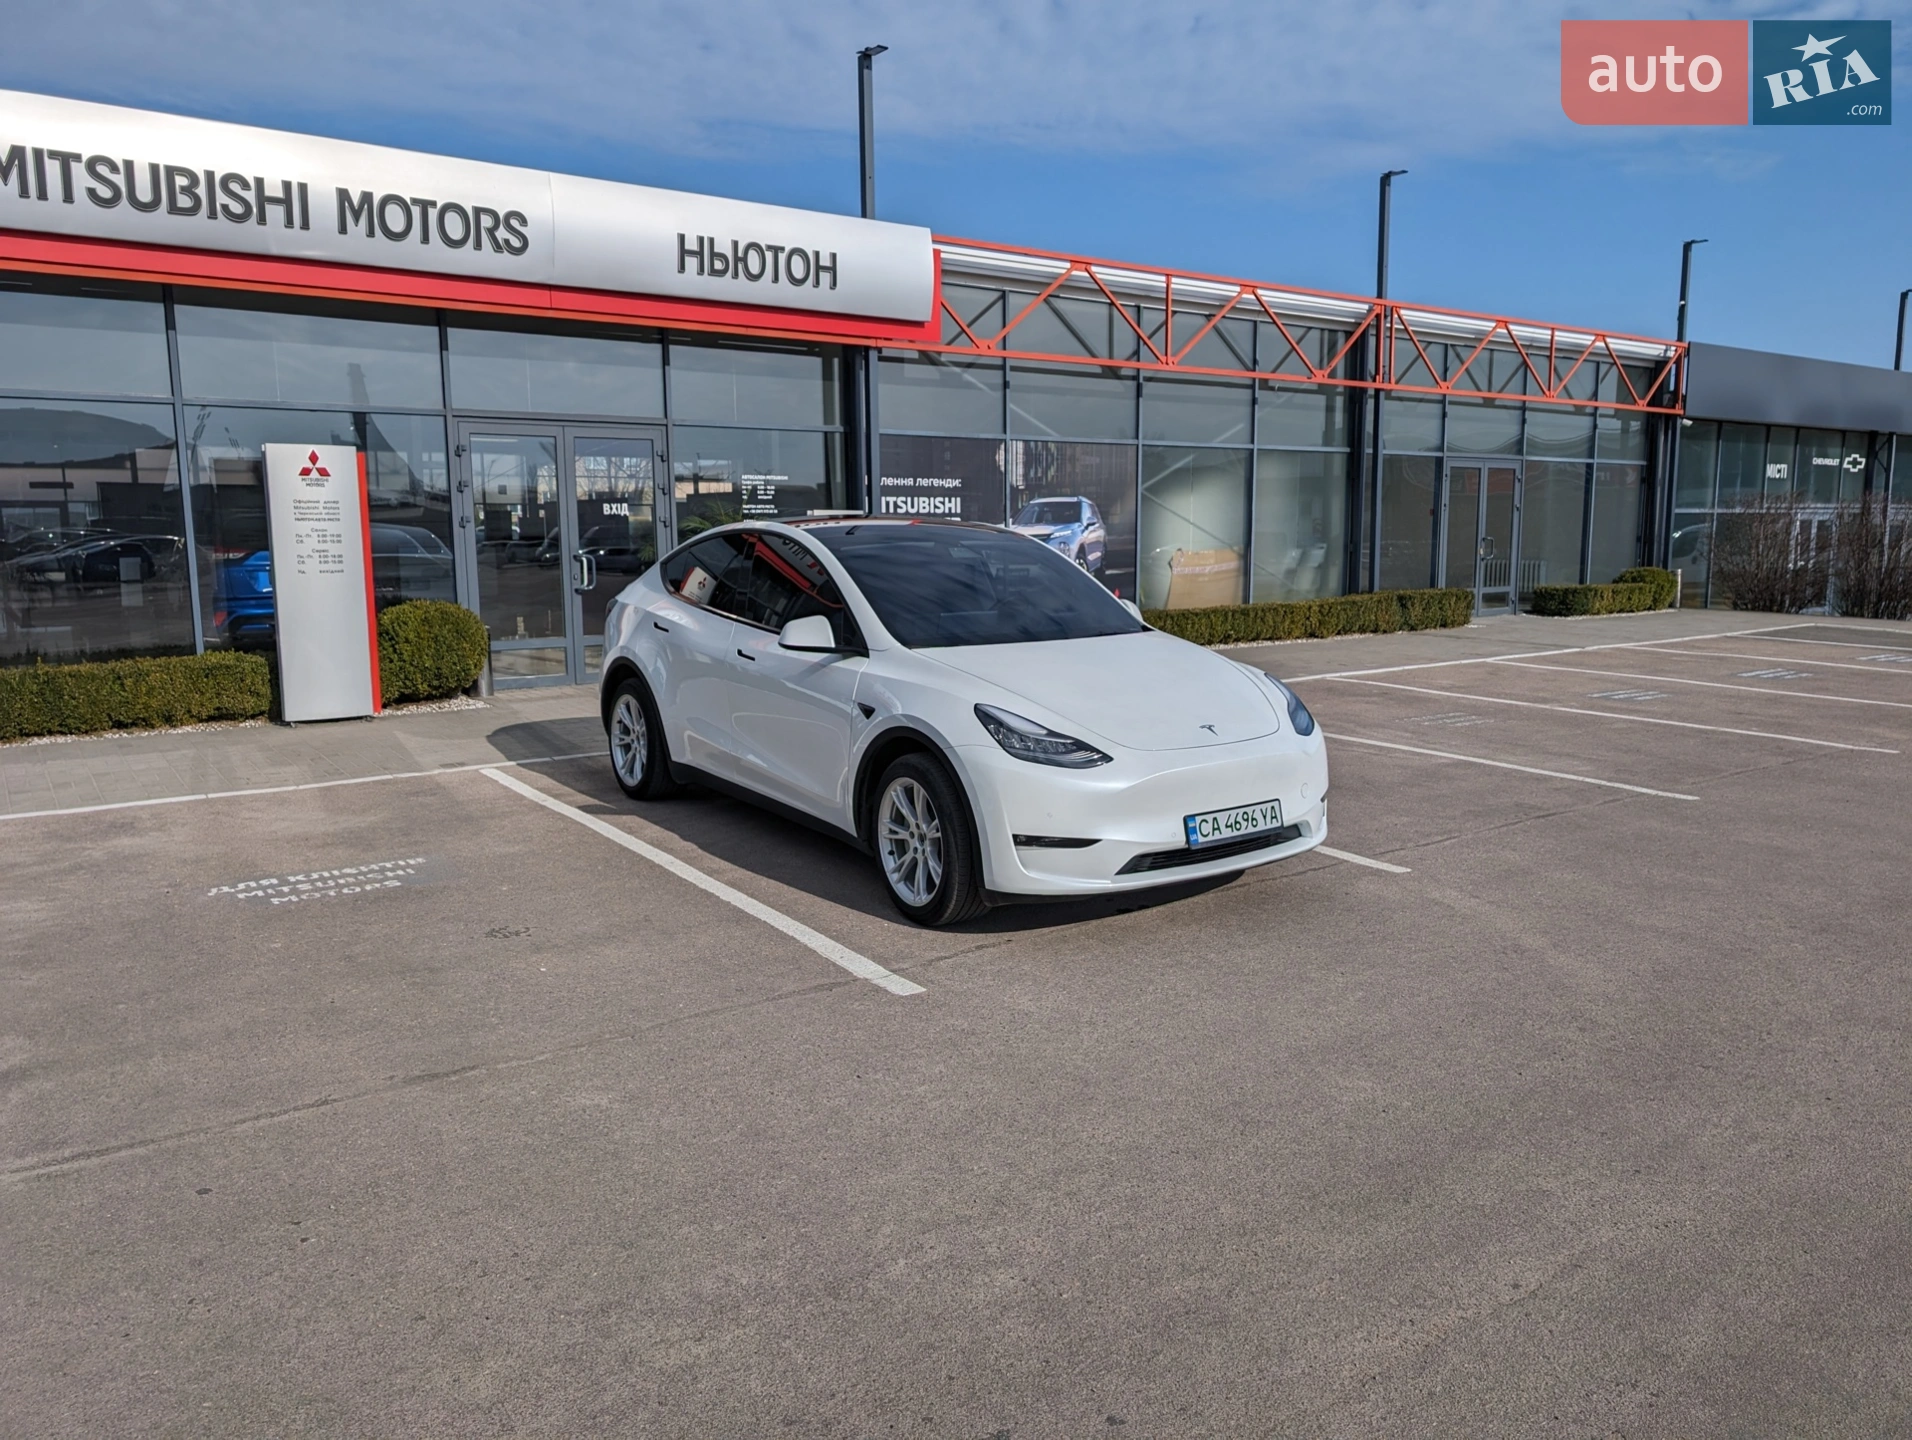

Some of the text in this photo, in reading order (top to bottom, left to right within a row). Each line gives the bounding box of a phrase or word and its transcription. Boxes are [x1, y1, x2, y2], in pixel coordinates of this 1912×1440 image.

[0, 144, 529, 255] MITSUBISHI MOTORS
[676, 232, 838, 291] НЬЮТОН
[1812, 457, 1840, 466] CHEVROLET
[916, 478, 962, 488] легенди:
[602, 502, 630, 517] ВХІД
[1198, 805, 1279, 838] CA 4696 YA
